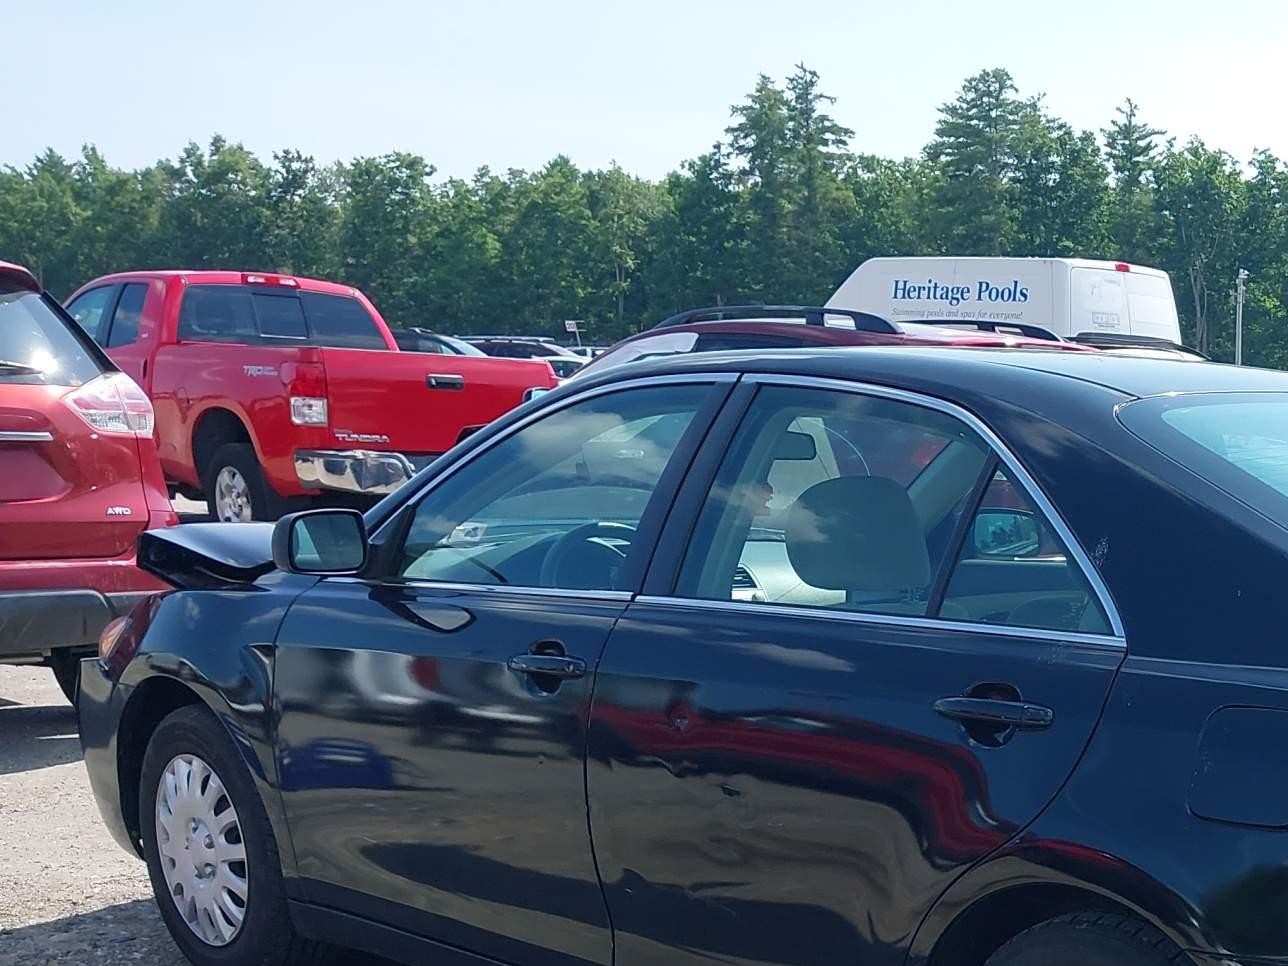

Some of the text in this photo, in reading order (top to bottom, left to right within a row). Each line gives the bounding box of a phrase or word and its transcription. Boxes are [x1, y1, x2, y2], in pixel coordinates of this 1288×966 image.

[892, 278, 1029, 307] Heritage Pools
[926, 308, 945, 319] pools
[945, 309, 959, 319] and
[977, 309, 988, 320] for
[335, 433, 390, 443] TUNDRA
[106, 506, 131, 515] AWD
